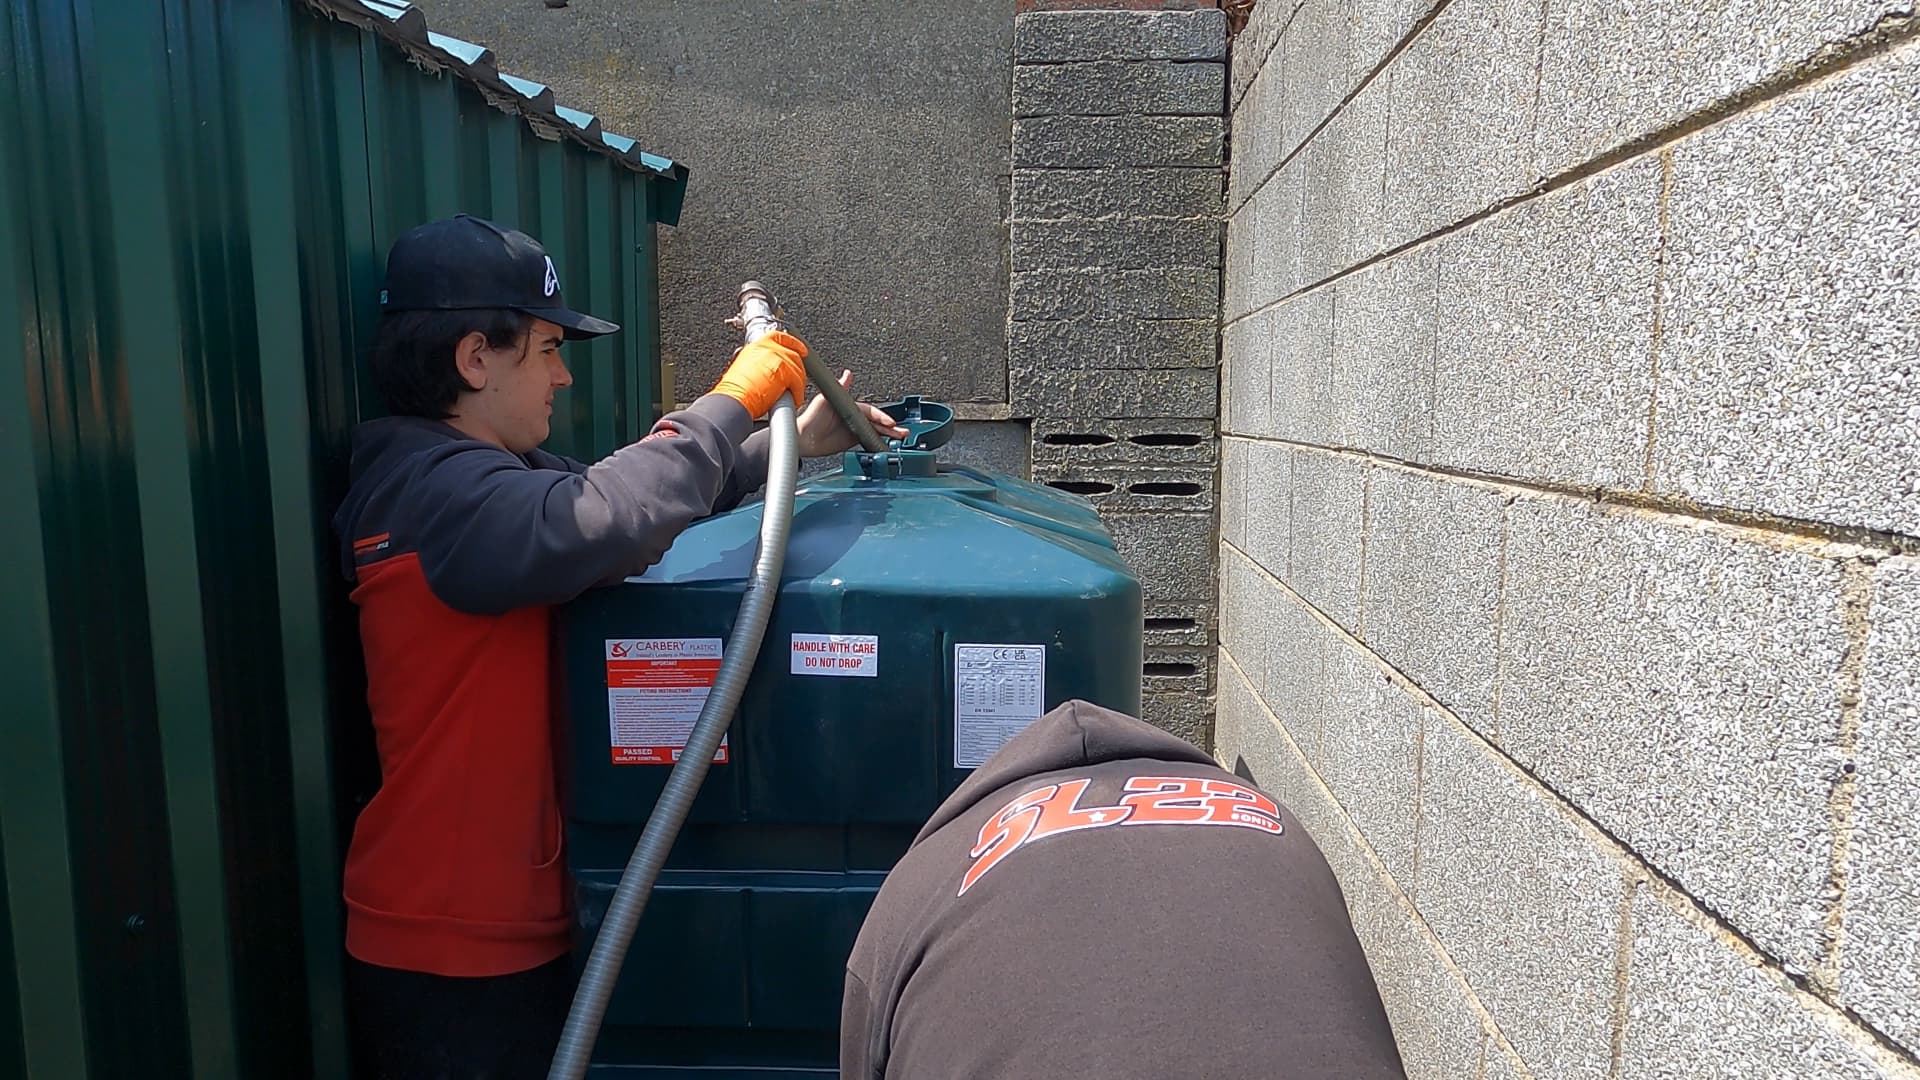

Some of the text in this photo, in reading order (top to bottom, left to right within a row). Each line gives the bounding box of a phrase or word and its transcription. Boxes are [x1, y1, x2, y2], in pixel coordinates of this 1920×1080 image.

[636, 641, 686, 651] CARBERY
[793, 641, 876, 654] HANDLE WITH CARE
[805, 657, 862, 668] DO NOT DROP
